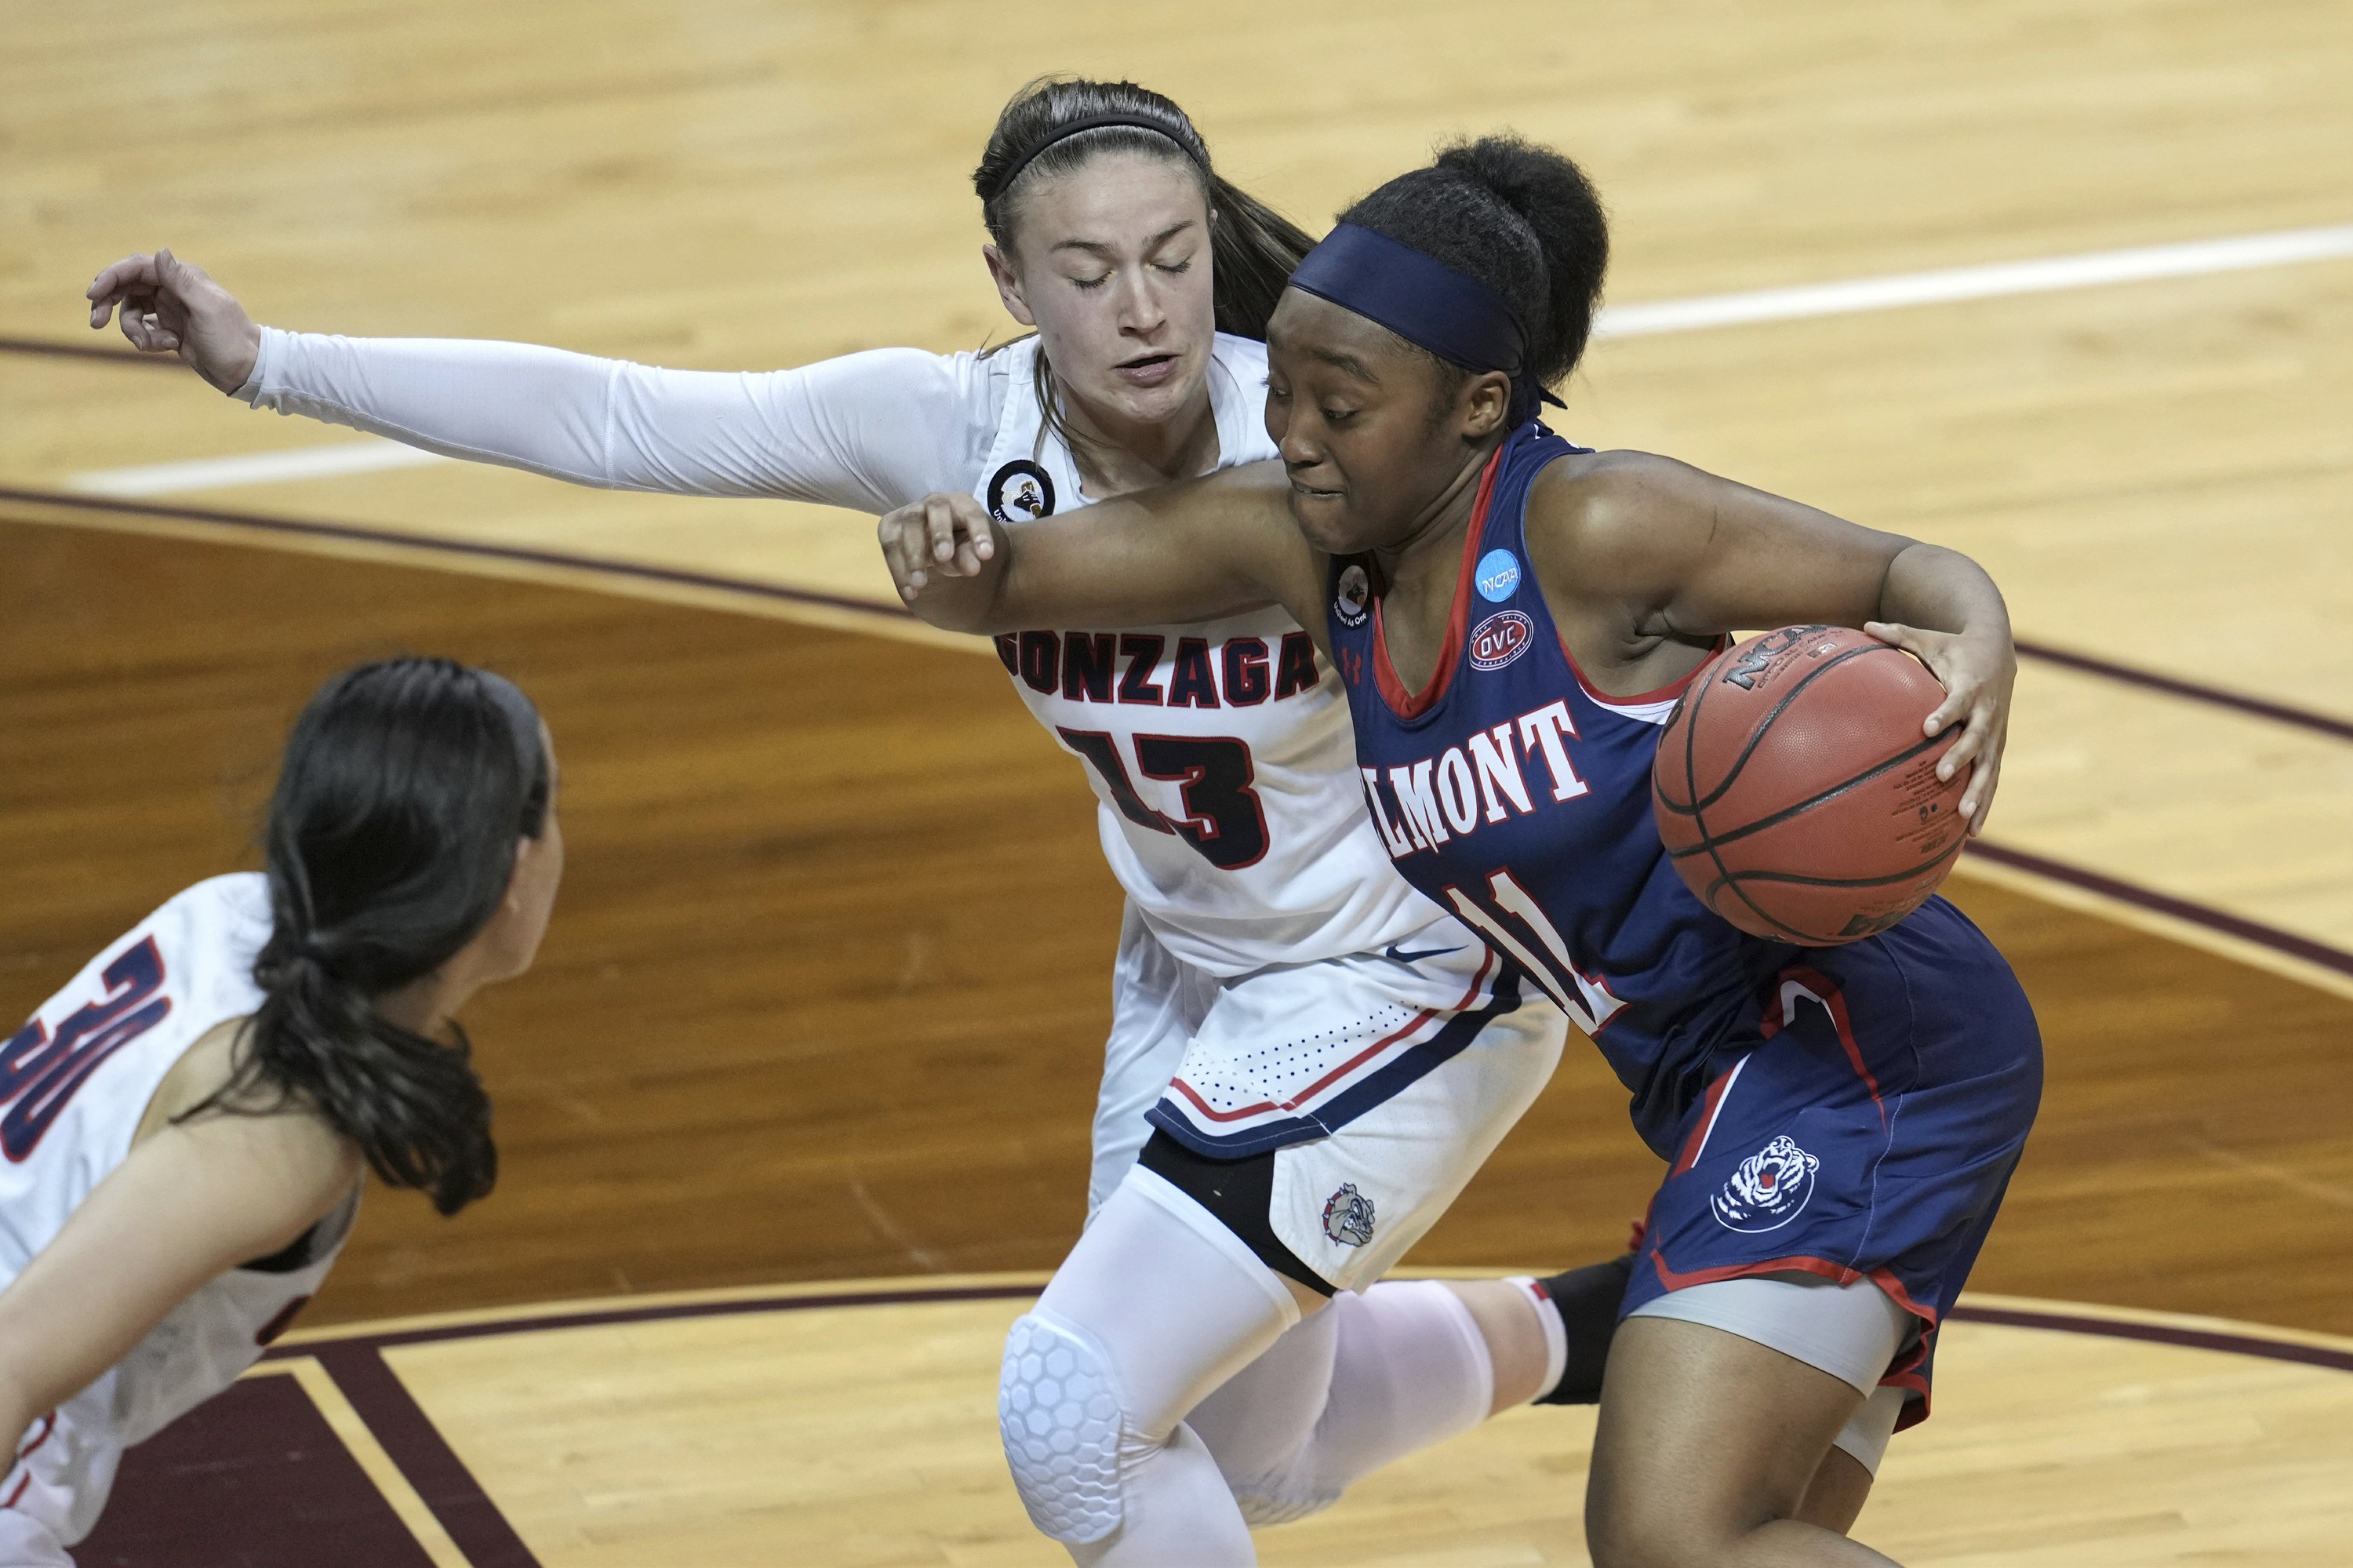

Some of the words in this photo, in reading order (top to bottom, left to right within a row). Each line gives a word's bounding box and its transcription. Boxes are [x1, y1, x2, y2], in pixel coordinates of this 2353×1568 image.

[1333, 601, 1347, 625] United
[1347, 618, 1355, 627] As
[1355, 613, 1367, 625] One
[1482, 567, 1518, 594] NCAA
[1501, 616, 1527, 624] VALLEY
[1481, 624, 1516, 657] OVC
[1056, 725, 1270, 871] 13
[1360, 697, 1591, 862] LMONT
[1442, 865, 1633, 1039] 11
[0, 934, 173, 1164] 30
